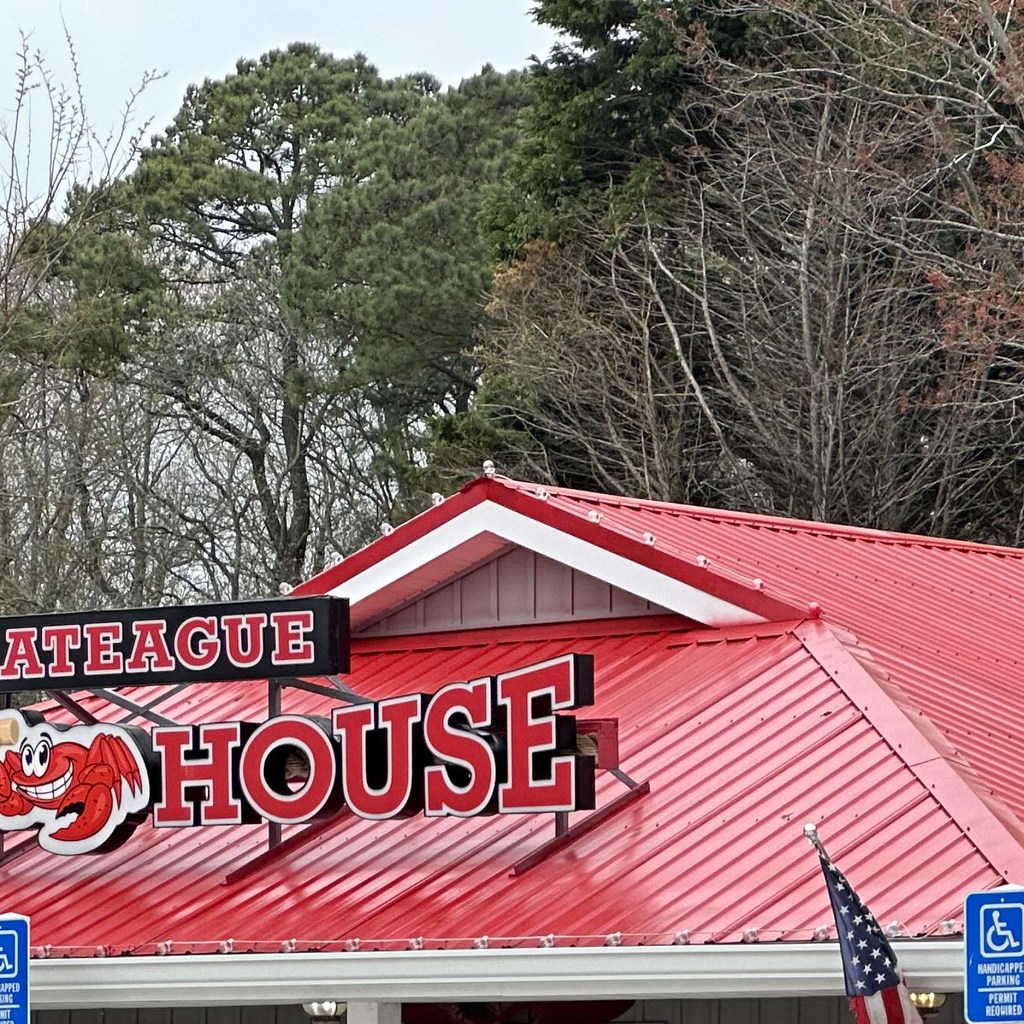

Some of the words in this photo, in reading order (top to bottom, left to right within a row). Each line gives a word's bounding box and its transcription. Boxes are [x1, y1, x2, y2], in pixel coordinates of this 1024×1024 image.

[152, 653, 580, 828] HOUSE
[977, 962, 1024, 975] HANDICAPPE
[986, 974, 1021, 986] PARKING
[988, 992, 1018, 1004] PERMIT
[985, 1004, 1023, 1017] REQUIRED
